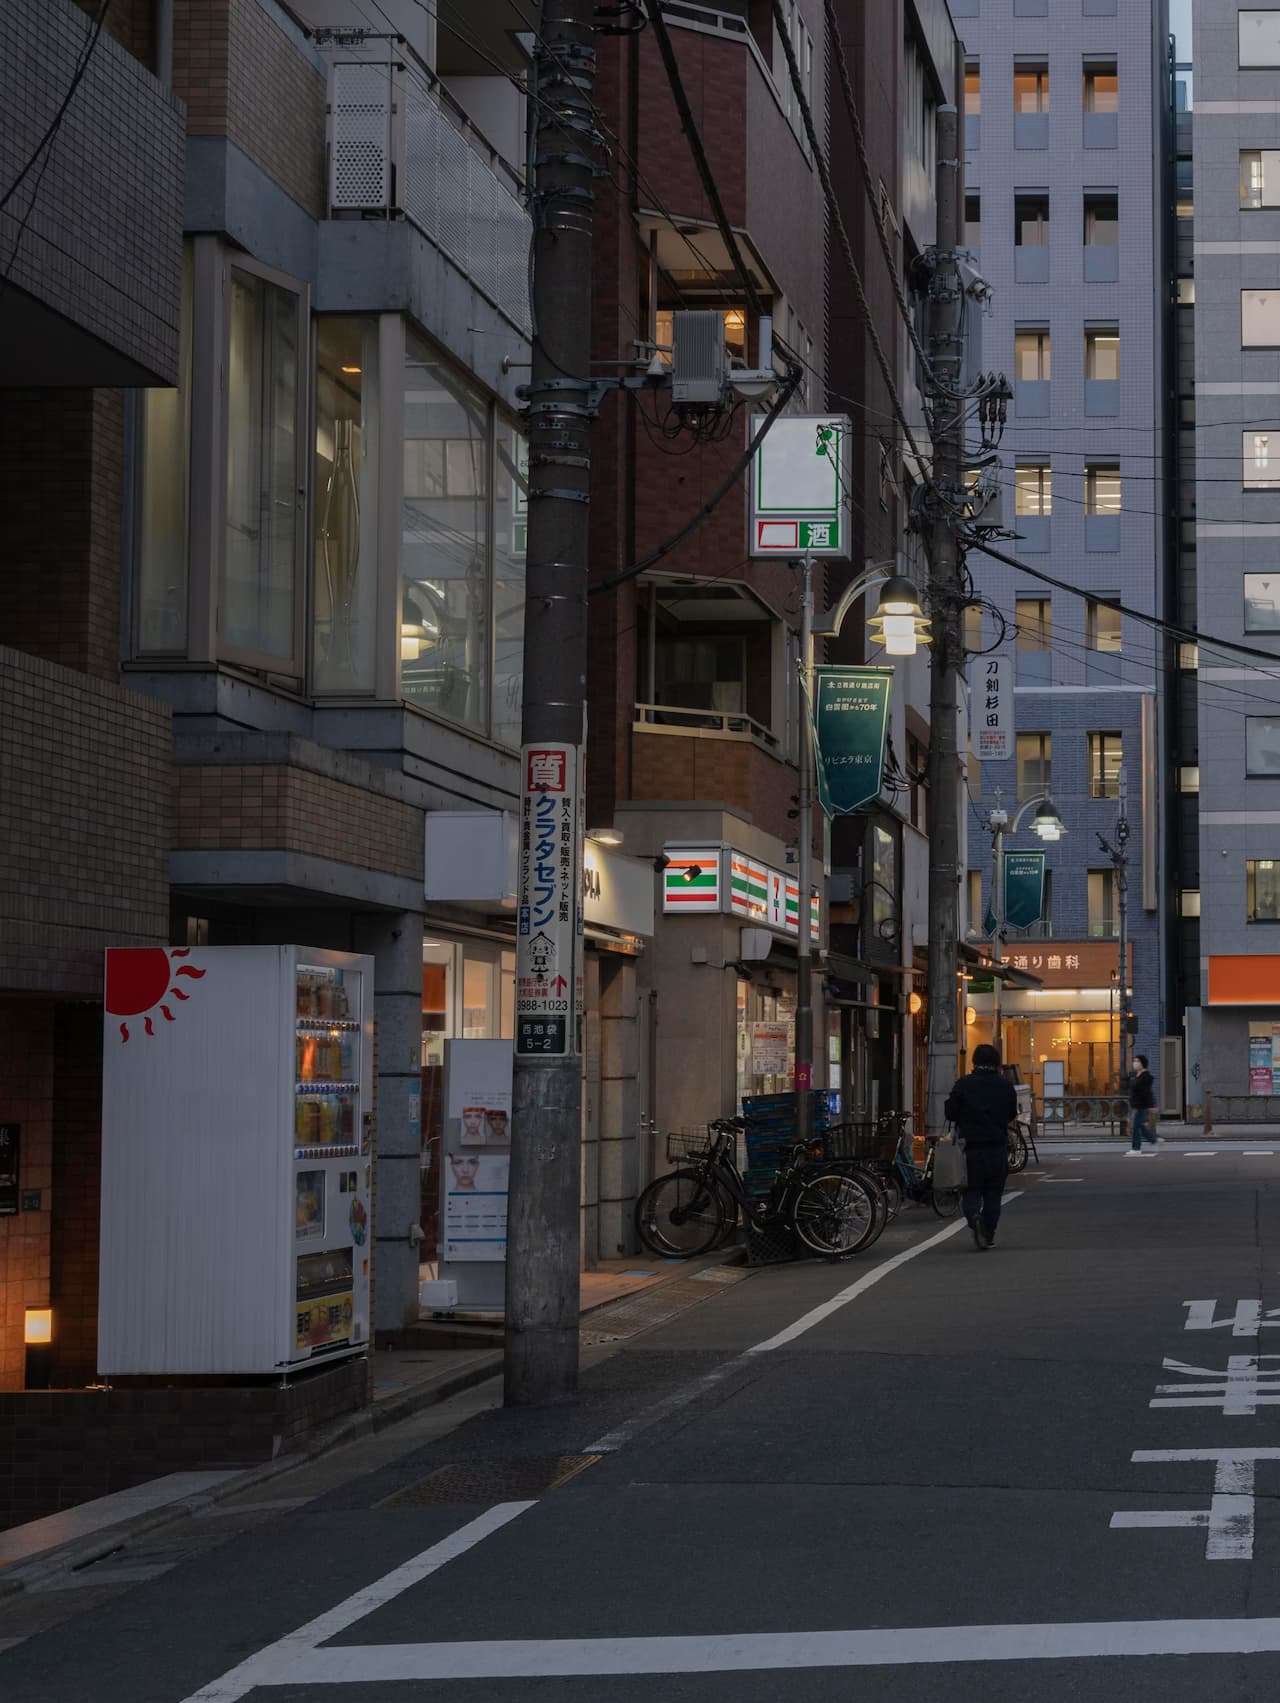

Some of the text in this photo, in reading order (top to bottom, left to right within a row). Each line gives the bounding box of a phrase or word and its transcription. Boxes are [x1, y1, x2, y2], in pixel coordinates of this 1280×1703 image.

[807, 523, 831, 547] 酒
[985, 660, 1000, 727] 刀剣杉田
[530, 753, 564, 790] 質
[534, 795, 557, 928] クラタセブン
[522, 1023, 558, 1035] 西池袋
[527, 1038, 552, 1049] 5-2
